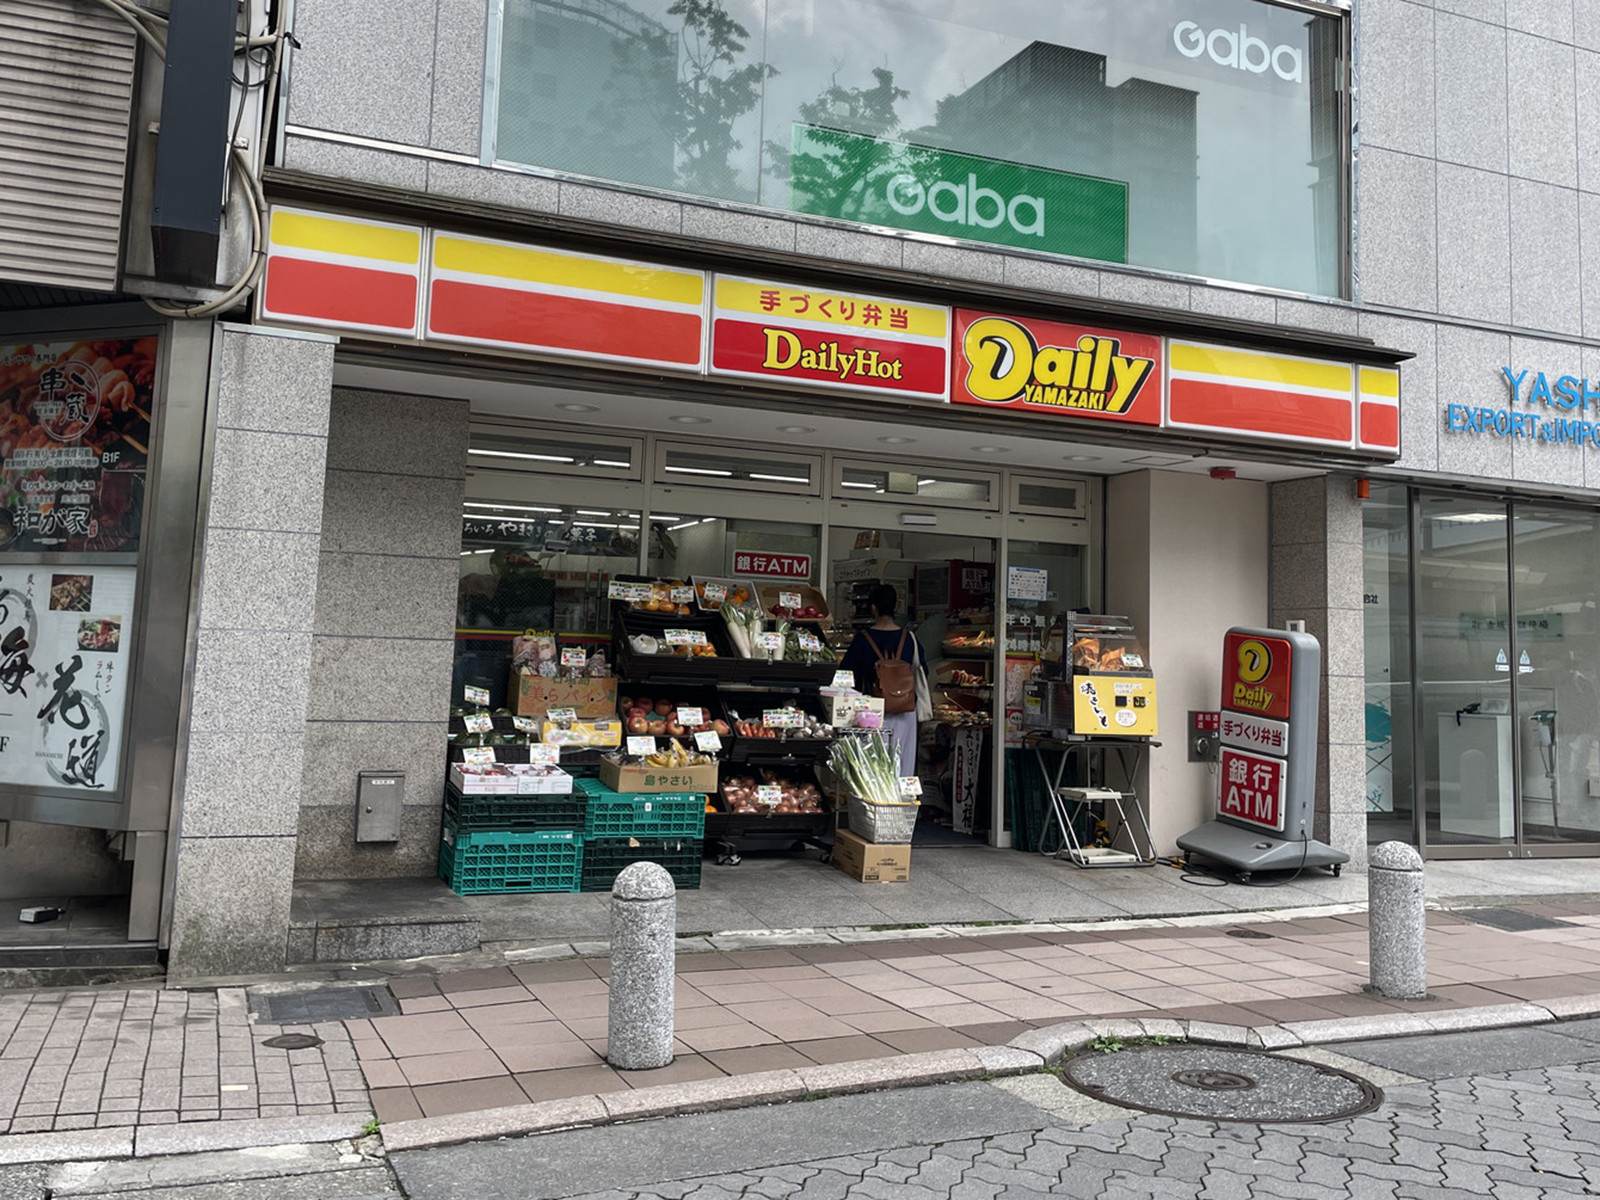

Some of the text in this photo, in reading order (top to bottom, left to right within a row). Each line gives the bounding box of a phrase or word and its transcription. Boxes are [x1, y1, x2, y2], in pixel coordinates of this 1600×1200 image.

[1173, 20, 1303, 84] Gaba
[886, 171, 1046, 237] Gaba
[760, 289, 909, 330] 手づくり弁当
[964, 316, 1152, 414] Daily
[1024, 383, 1106, 411] YAMAZAKI
[102, 452, 120, 464] B1F
[14, 506, 91, 537] 和が家
[737, 555, 807, 575] 銀行ATM
[1233, 682, 1276, 711] Daily
[1223, 720, 1283, 748] 手づくり弁当
[643, 775, 693, 786] 島やさい
[1228, 757, 1273, 793] 銀行
[1225, 785, 1273, 821] ATM
